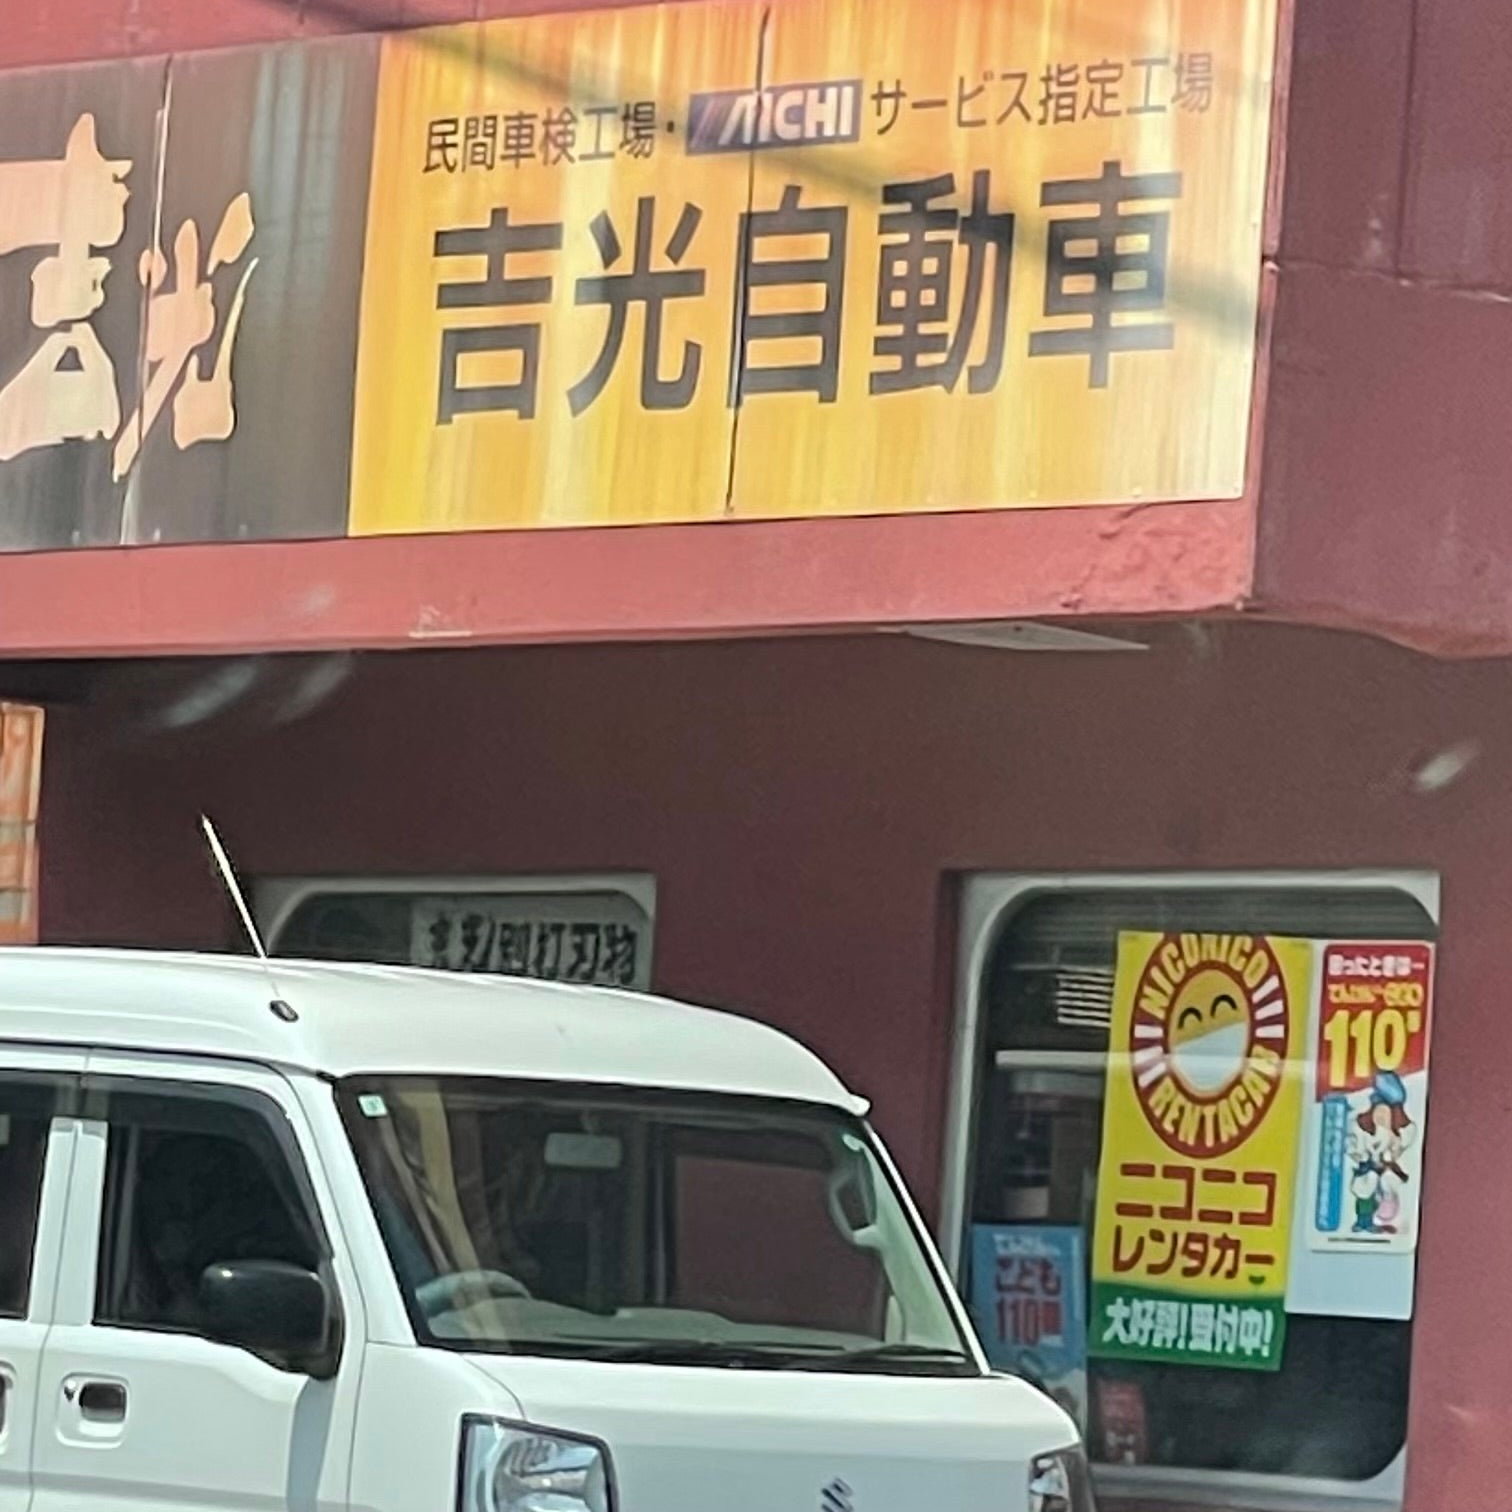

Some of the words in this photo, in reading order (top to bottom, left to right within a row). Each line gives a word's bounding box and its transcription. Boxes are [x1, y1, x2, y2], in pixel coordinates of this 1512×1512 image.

[714, 85, 856, 149] AICHI
[869, 51, 1214, 135] サービス指定工場
[432, 160, 1184, 426] 吉光自動車
[1139, 933, 1270, 1019] NICONICO
[1148, 1044, 1281, 1148] RENTACAR
[1115, 1163, 1276, 1227] ニコニコ
[1113, 1225, 1275, 1279] レンタカー
